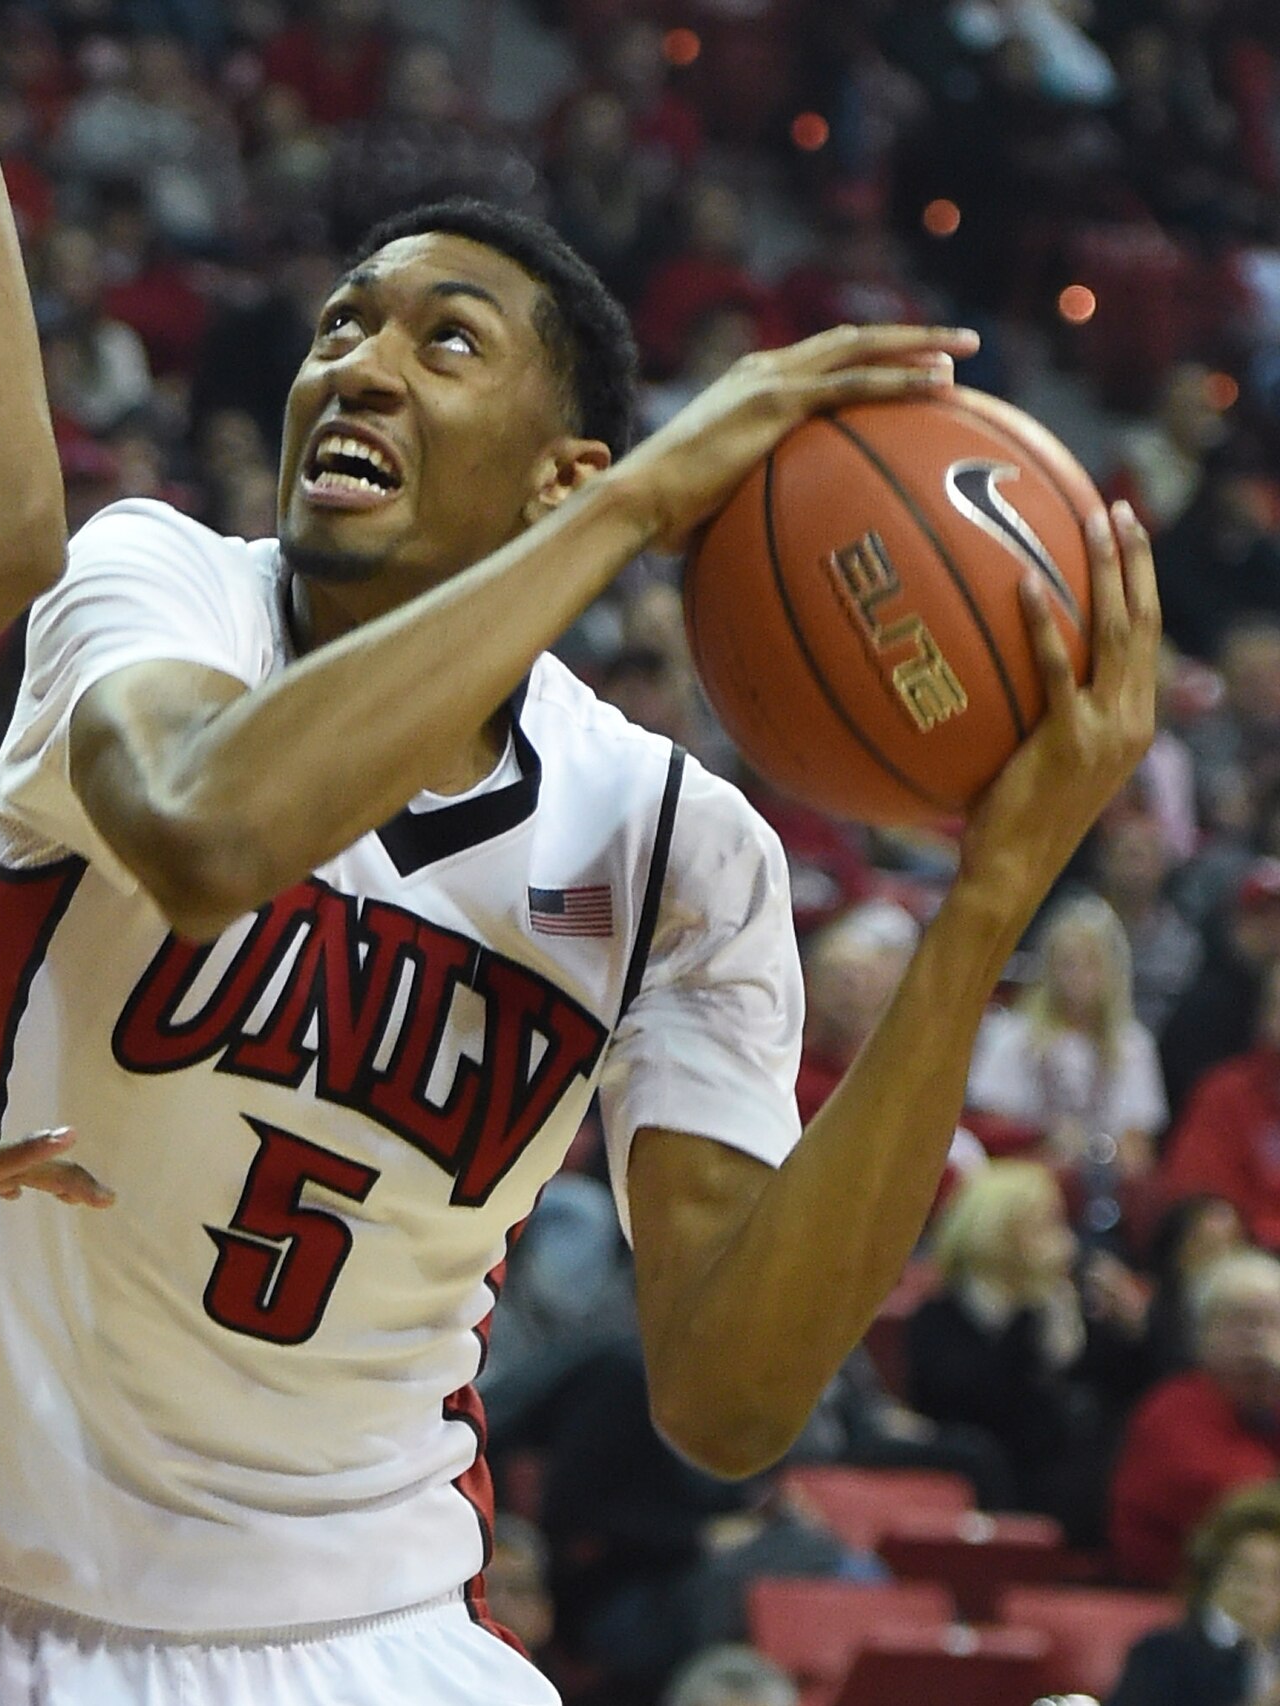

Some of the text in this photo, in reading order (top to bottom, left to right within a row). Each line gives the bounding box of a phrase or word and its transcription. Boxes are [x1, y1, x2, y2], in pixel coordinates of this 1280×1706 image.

[828, 530, 970, 733] ELITE
[111, 875, 609, 1209] UNLV
[202, 1111, 380, 1347] 5
